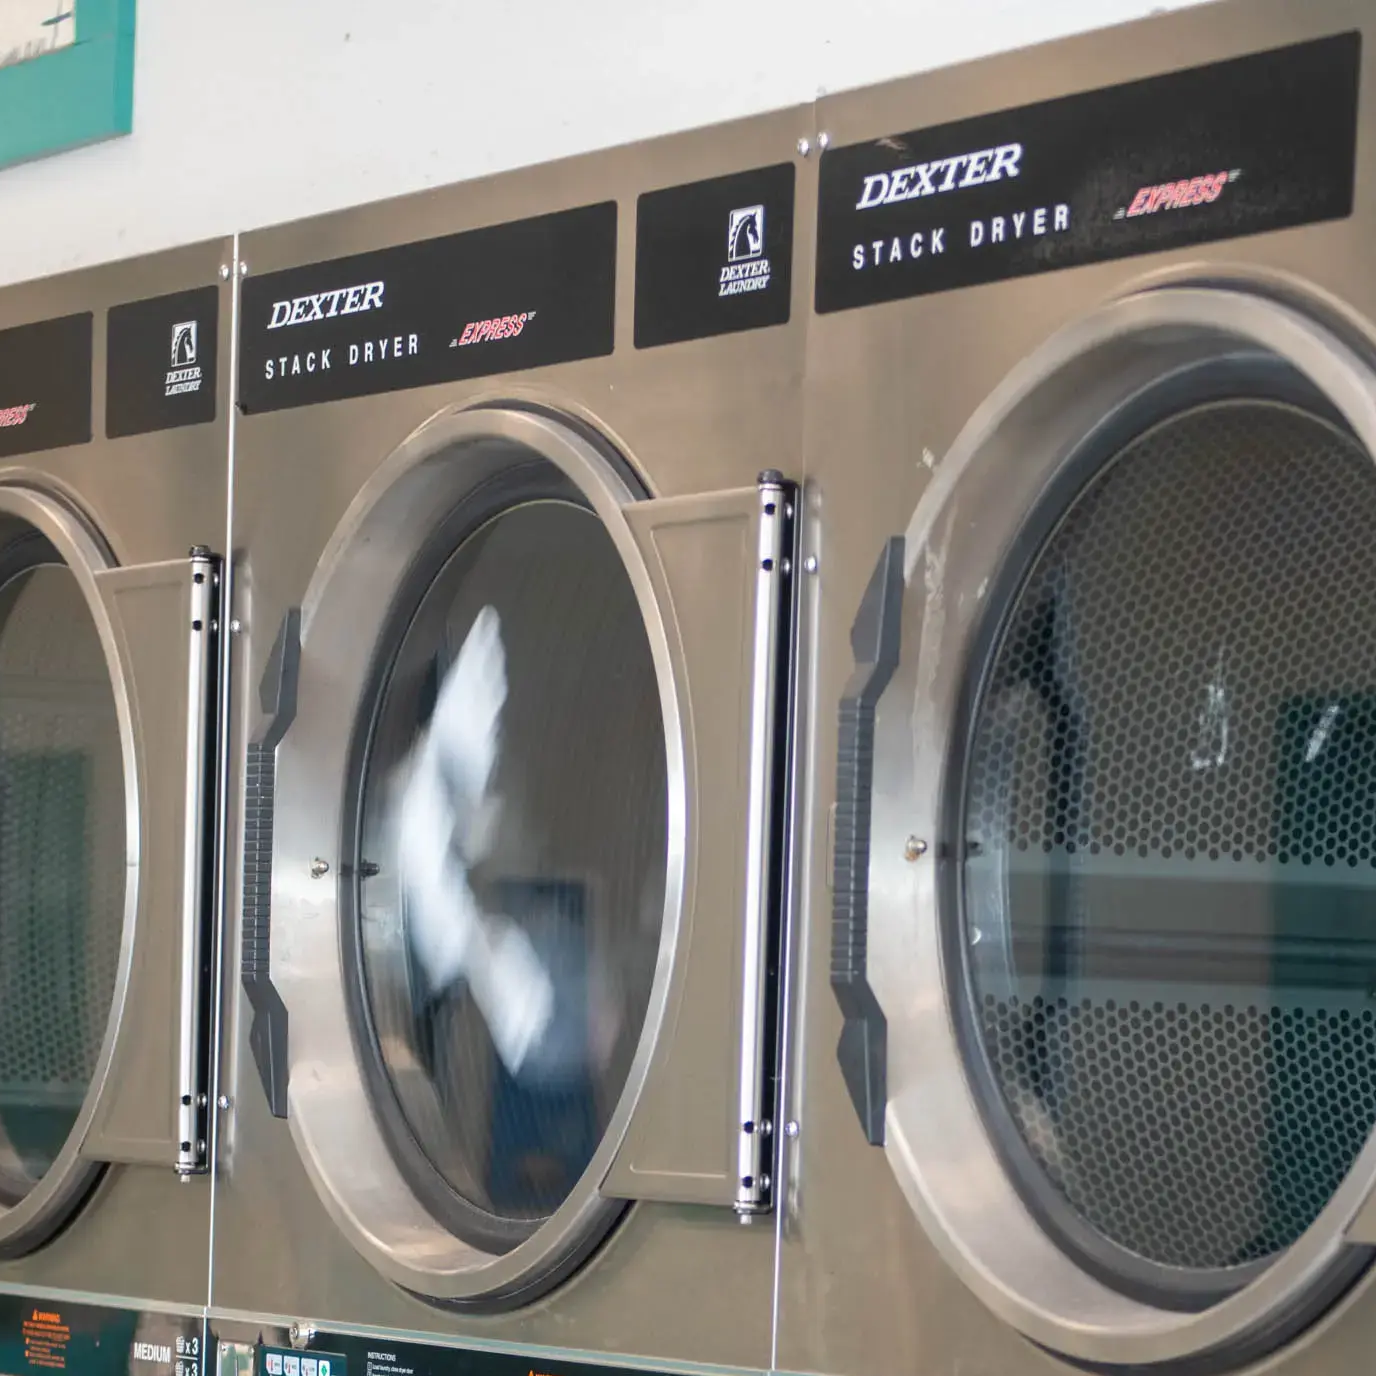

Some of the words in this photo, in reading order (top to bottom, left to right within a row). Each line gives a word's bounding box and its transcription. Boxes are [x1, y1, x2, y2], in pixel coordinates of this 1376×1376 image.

[856, 142, 1022, 210] DEXTER
[1127, 170, 1229, 217] EXPRESS
[852, 227, 946, 270] STACK
[970, 204, 1070, 247] DRYER
[718, 275, 770, 297] LAUNDRY
[719, 259, 770, 283] DEXTER
[267, 280, 384, 330] DEXTER
[458, 312, 528, 346] EXPRESS
[265, 348, 332, 380] STACK
[349, 333, 418, 366] DRYER
[133, 1342, 171, 1363] MEDIUM
[367, 1351, 396, 1362] INSTRUCTIONS
